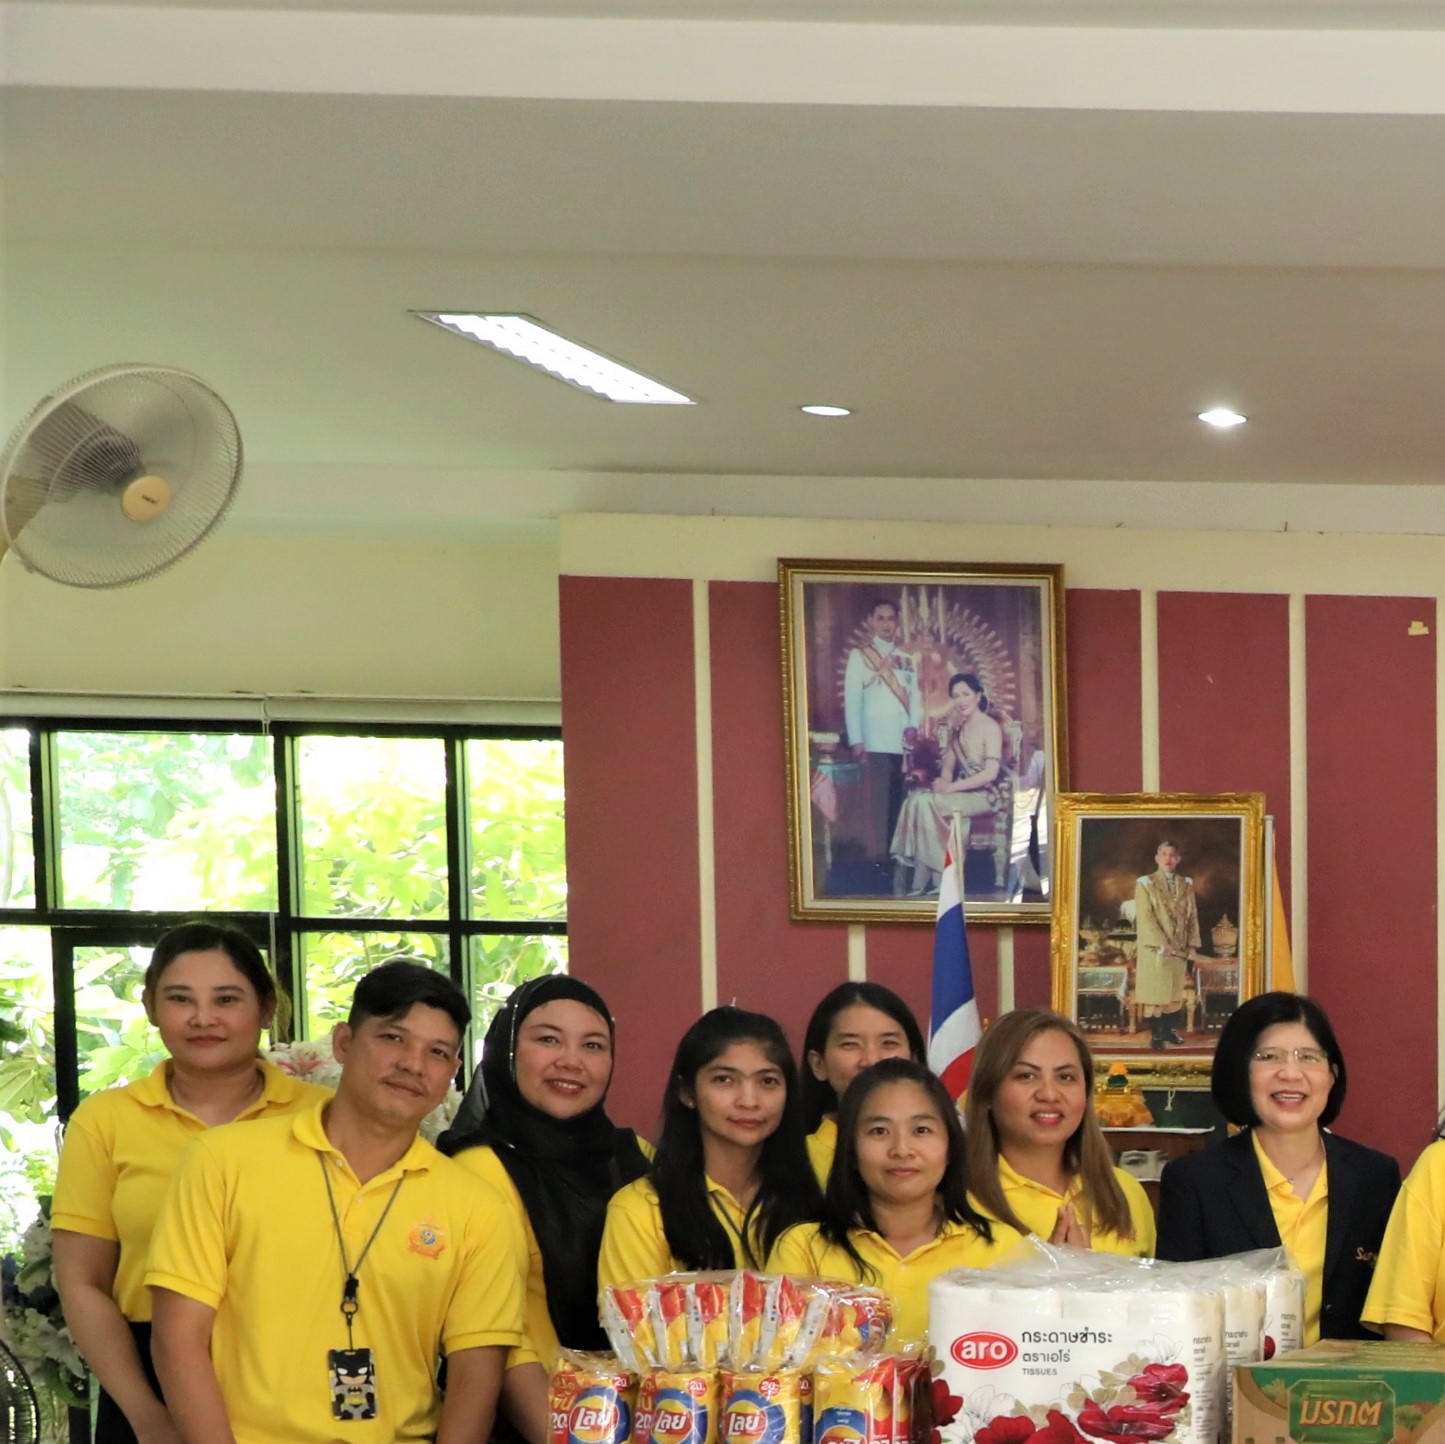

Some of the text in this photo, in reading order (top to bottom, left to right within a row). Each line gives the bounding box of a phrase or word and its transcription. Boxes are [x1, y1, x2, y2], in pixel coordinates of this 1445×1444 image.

[1021, 1326, 1113, 1345] กระดาษชำระ
[961, 1339, 1008, 1360] aro
[1021, 1349, 1071, 1364] ตราเอโร่
[1021, 1367, 1058, 1376] TISSUES
[1300, 1398, 1381, 1427] มรกต
